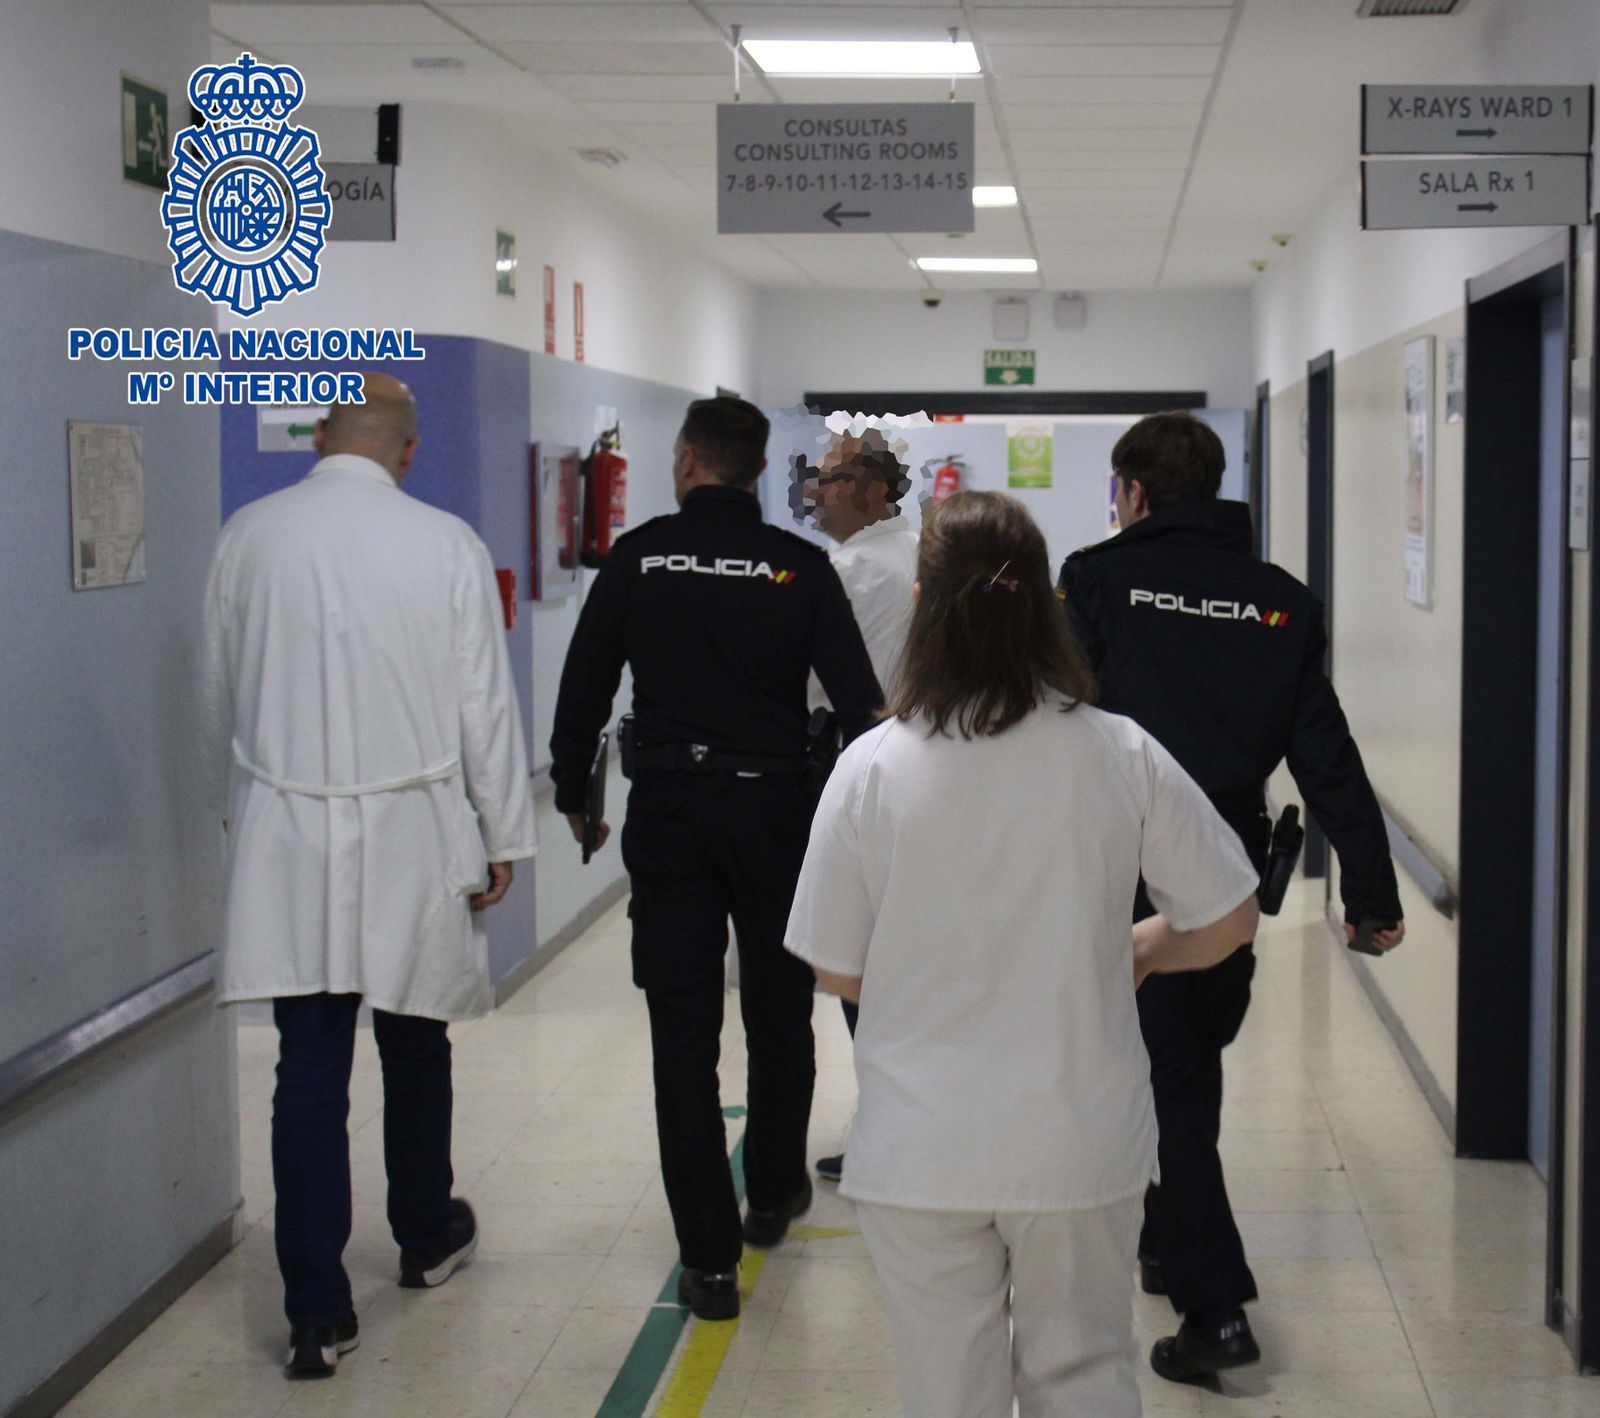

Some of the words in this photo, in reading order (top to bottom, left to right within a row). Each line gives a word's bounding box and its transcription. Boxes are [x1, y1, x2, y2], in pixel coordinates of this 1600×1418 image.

[1388, 97, 1471, 118] X-RAYS
[1481, 97, 1552, 118] WARD
[1562, 97, 1573, 117] 1
[784, 119, 908, 138] CONSULTAS
[735, 143, 871, 161] CONSULTING
[879, 142, 958, 160] ROOMS
[327, 176, 385, 201] OGÍA
[726, 173, 967, 192] 7-8-9-10-11-12-13-14-15
[1419, 172, 1479, 194] SALA
[1489, 171, 1514, 191] Rx
[1523, 171, 1534, 190] 1
[641, 554, 774, 580] POLICIA
[1130, 588, 1262, 622] POLICIA
